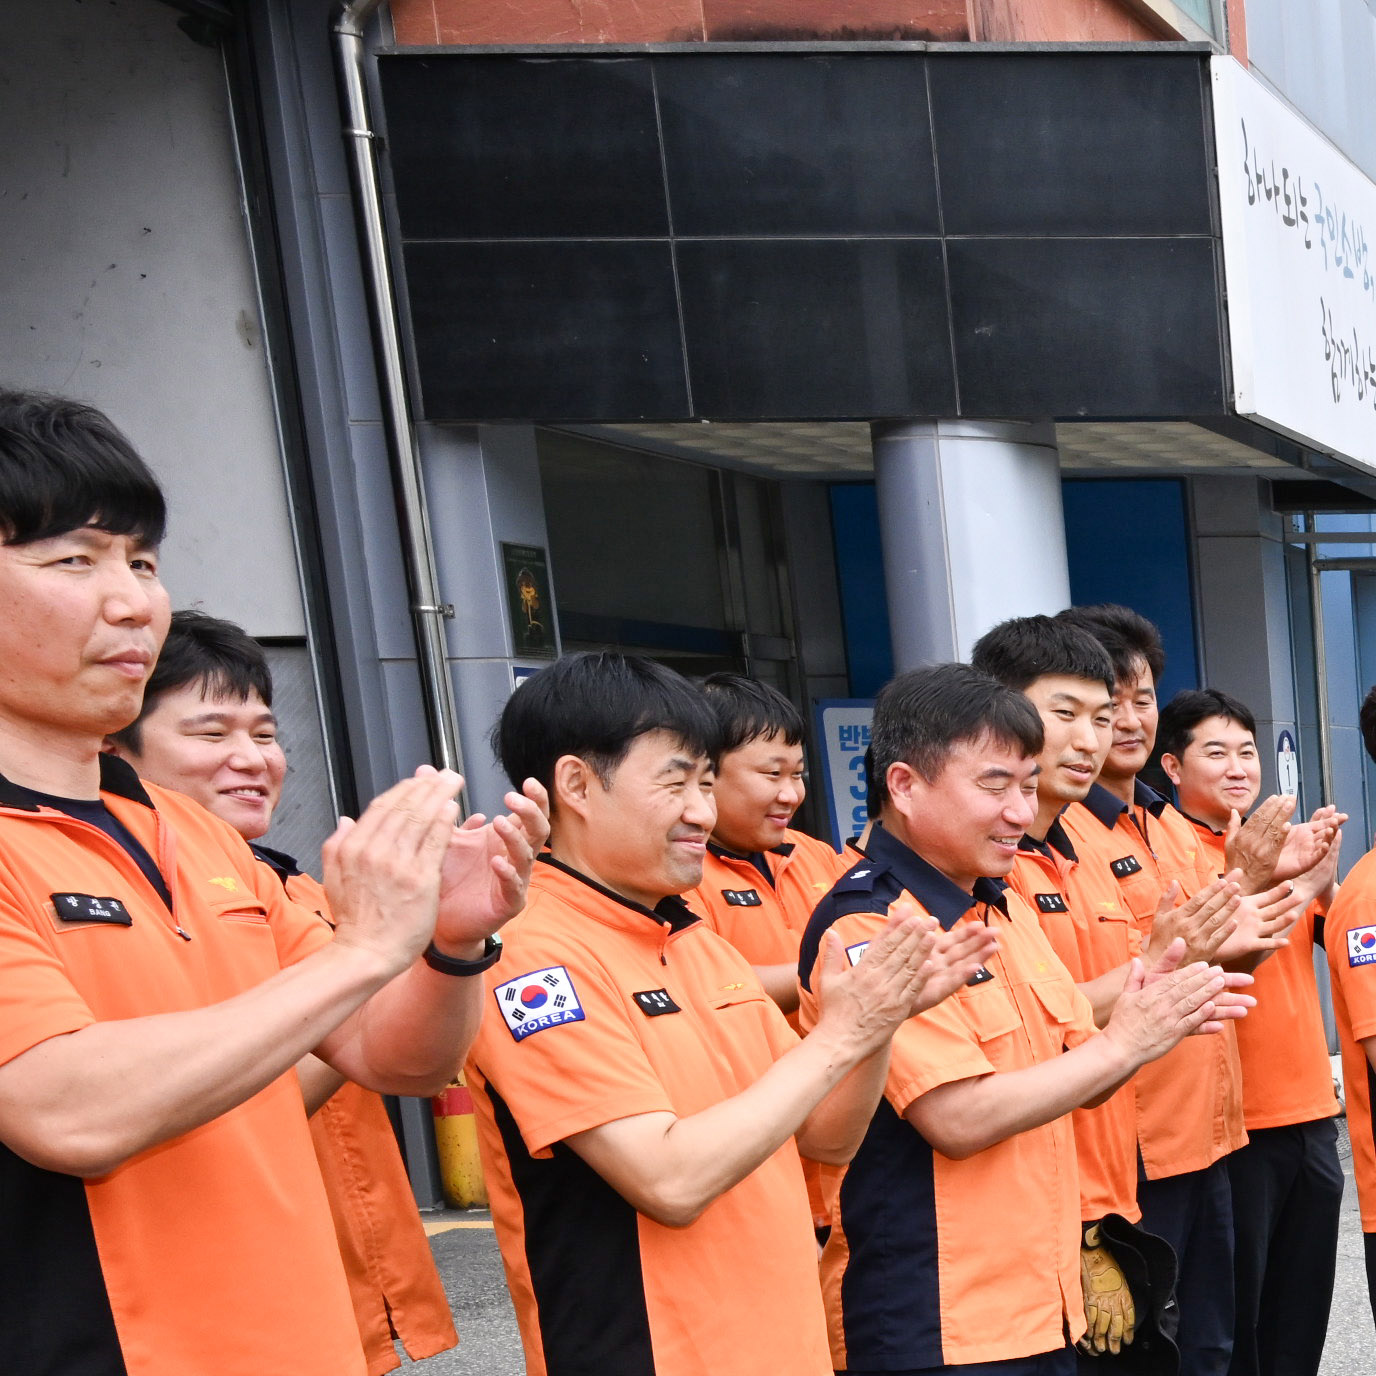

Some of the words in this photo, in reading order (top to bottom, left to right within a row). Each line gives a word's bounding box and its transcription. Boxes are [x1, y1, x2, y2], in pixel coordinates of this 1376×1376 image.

[1241, 117, 1311, 249] 하나되는
[1314, 182, 1374, 302] 국민소방,
[89, 908, 111, 917] BANG
[517, 1010, 577, 1036] KOREA
